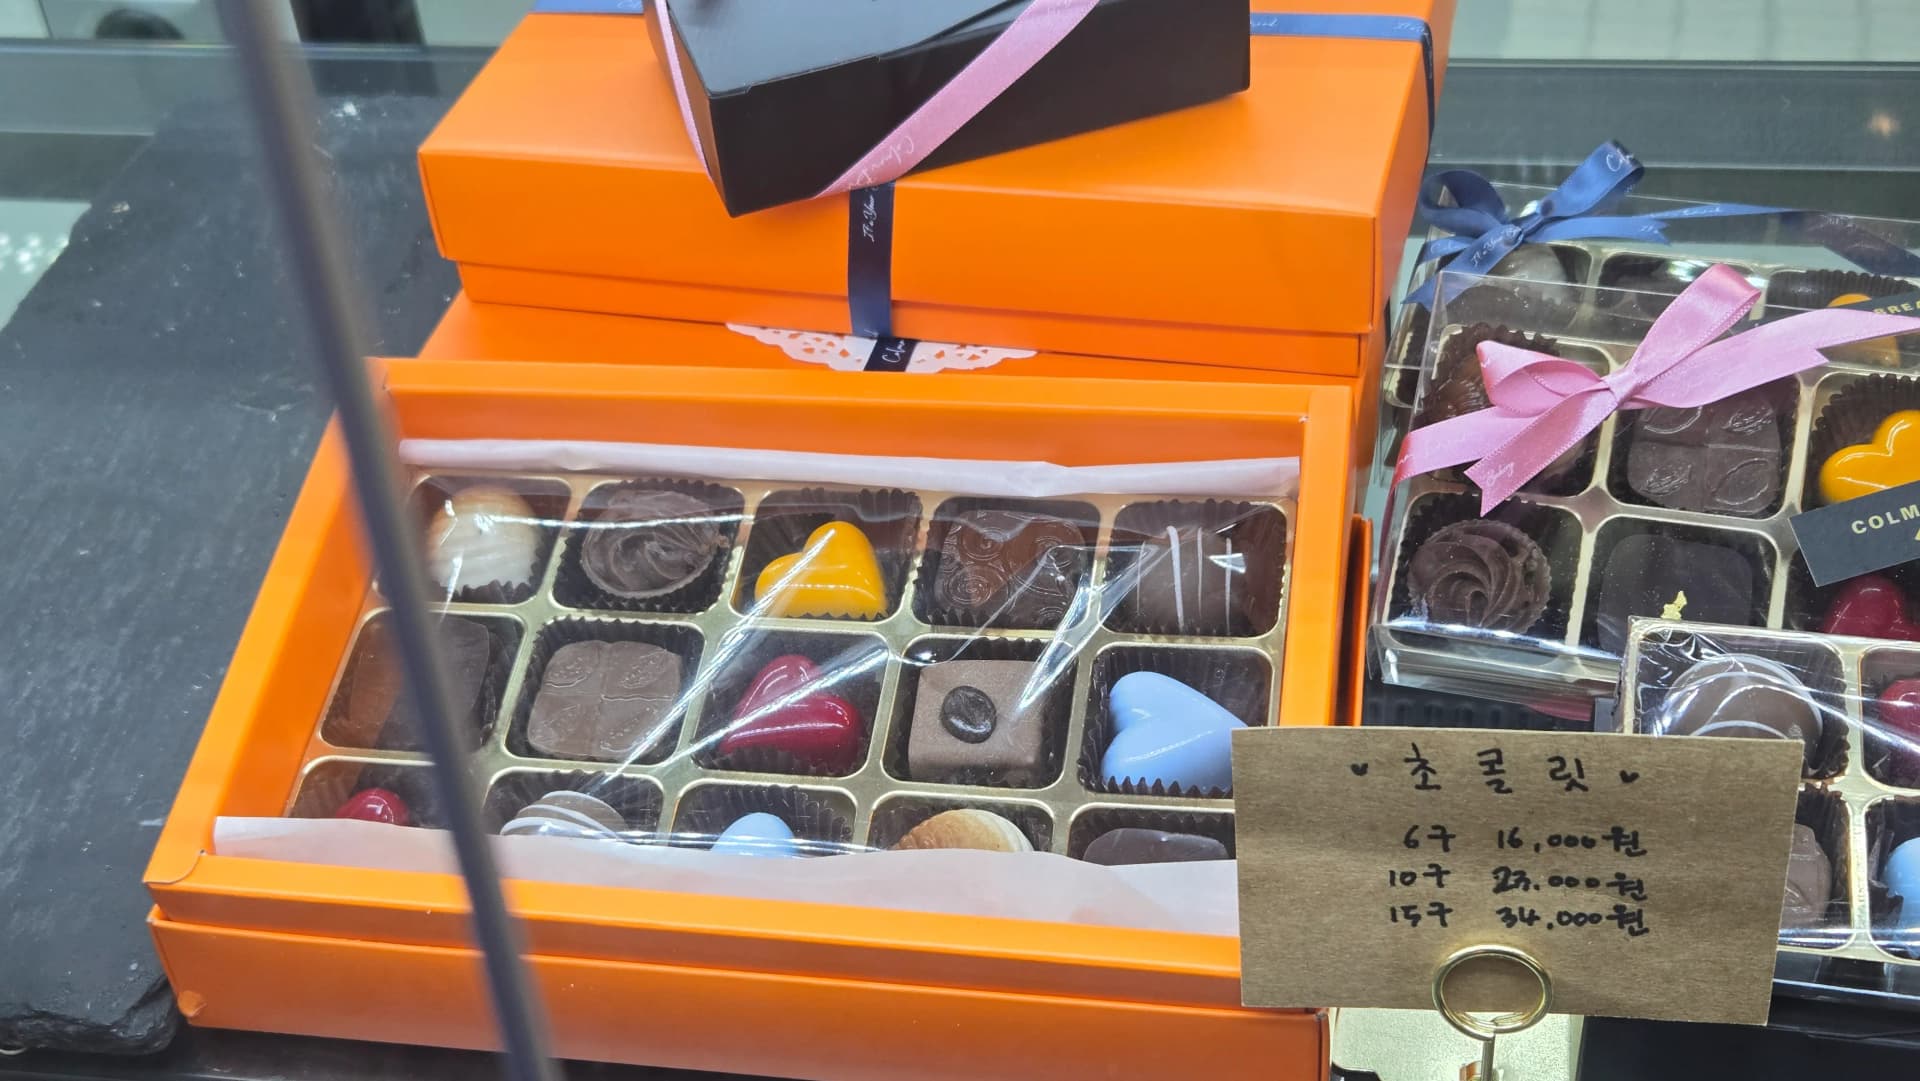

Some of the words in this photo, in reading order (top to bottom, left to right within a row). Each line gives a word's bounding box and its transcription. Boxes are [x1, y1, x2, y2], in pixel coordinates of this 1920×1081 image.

[1403, 824, 1457, 852] 6구
[1497, 826, 1647, 857] 16,000원
[1388, 863, 1451, 889] 10구
[1390, 901, 1454, 928] 15구
